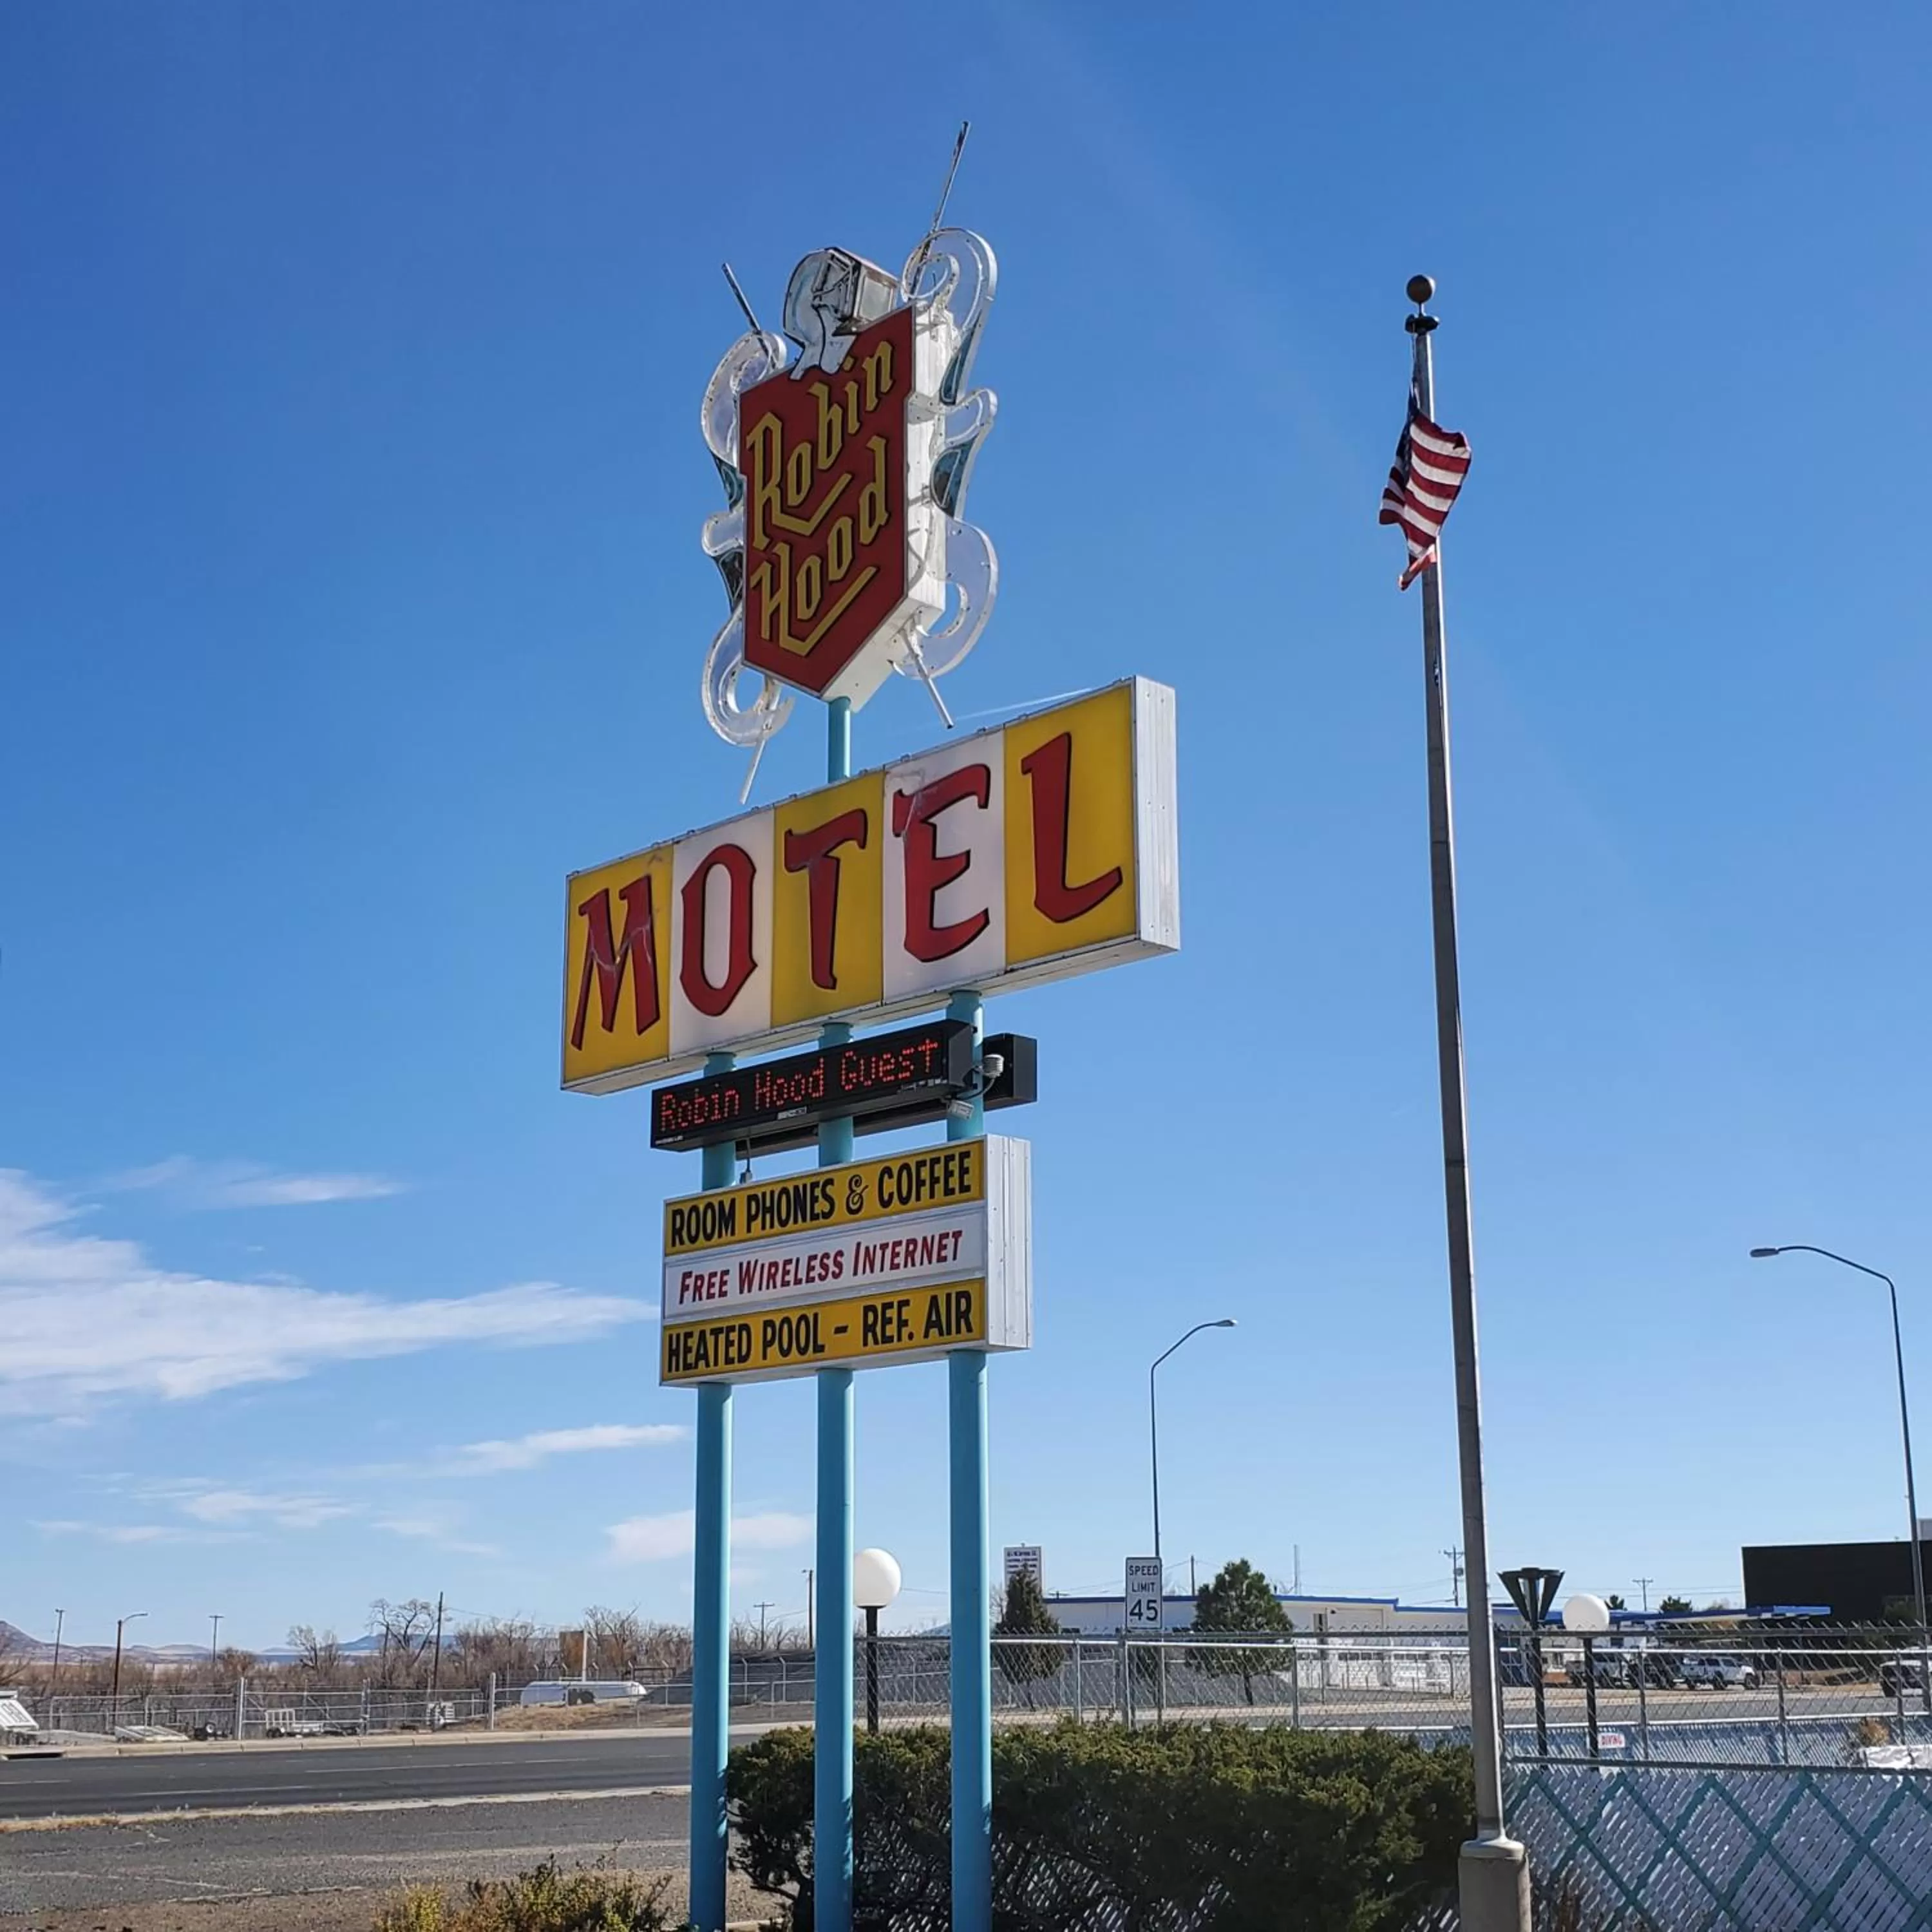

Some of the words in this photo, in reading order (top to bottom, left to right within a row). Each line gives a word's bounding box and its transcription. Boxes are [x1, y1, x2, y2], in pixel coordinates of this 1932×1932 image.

[746, 340, 893, 551] Robin
[751, 435, 889, 656] Hood
[571, 732, 1123, 1052] MOTEL
[659, 1083, 741, 1132] Robin
[754, 1057, 825, 1111] Hood
[840, 1037, 939, 1091] Guest
[670, 1197, 737, 1248] ROOM
[746, 1177, 836, 1235] PHONES
[845, 1174, 869, 1216] &
[877, 1150, 972, 1209] COFFEE
[678, 1269, 730, 1305] FREE
[738, 1250, 844, 1295] WIRELESS
[852, 1229, 963, 1278] INTERNET
[667, 1322, 752, 1374] HEATED
[761, 1312, 826, 1361] POOL
[862, 1298, 915, 1348] REF.
[922, 1290, 974, 1339] AIR
[1128, 1564, 1159, 1576] SPEED
[1129, 1598, 1158, 1622] 45
[1132, 1581, 1156, 1593] LIMIT
